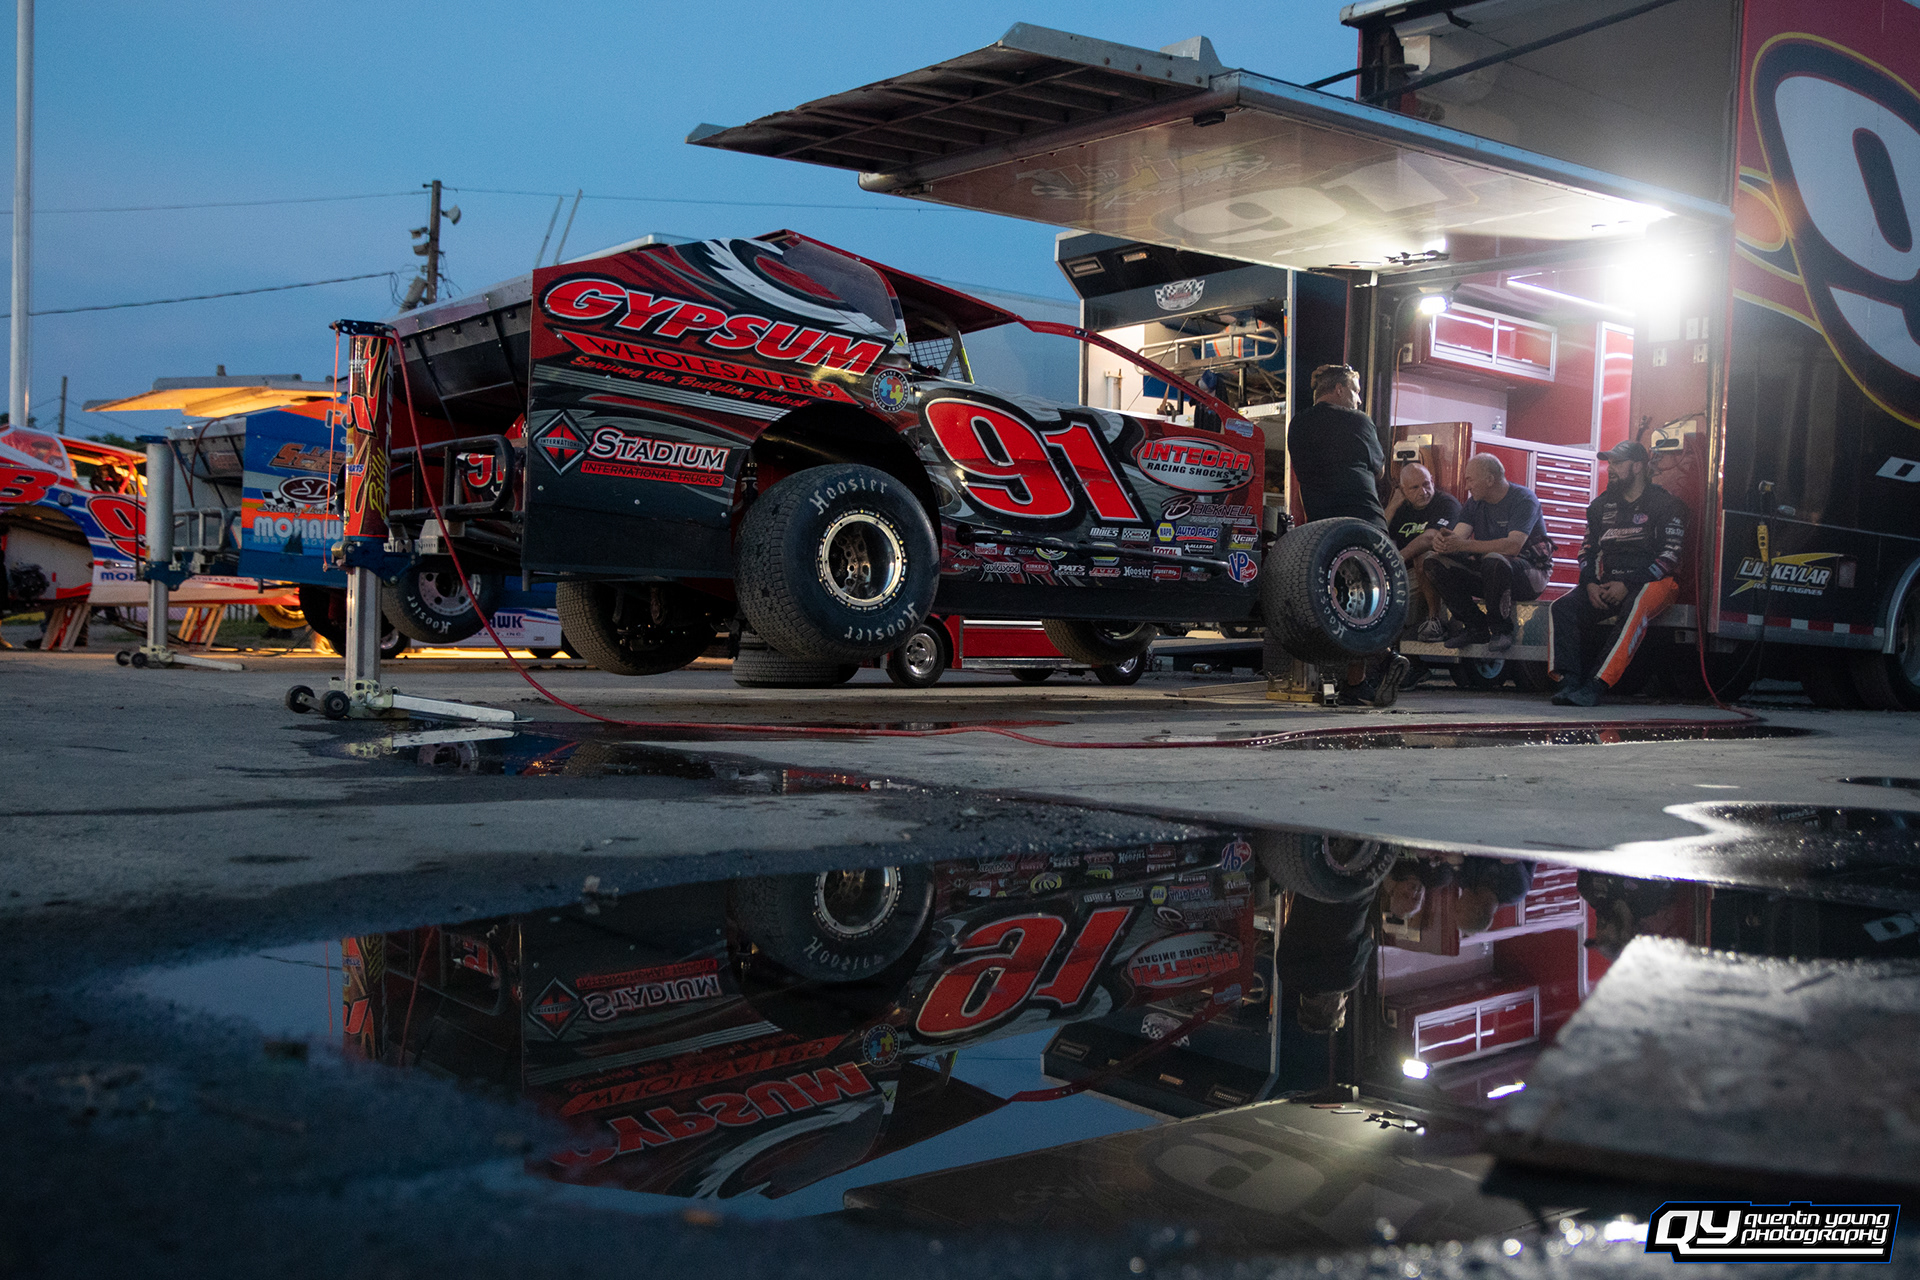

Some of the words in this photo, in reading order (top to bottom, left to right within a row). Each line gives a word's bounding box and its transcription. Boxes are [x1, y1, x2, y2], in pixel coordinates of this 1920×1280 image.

[545, 278, 885, 375] GYPSUM
[585, 338, 836, 398] WHOLESALERS
[645, 370, 677, 384] the
[678, 376, 754, 400] Building
[587, 427, 731, 472] STADIUM
[926, 398, 1142, 522] 91
[1142, 441, 1251, 470] INTEGRA
[584, 463, 669, 482] INTERNATIONAL
[676, 474, 723, 486] TRUCKS
[1147, 462, 1186, 474] RACING
[1189, 467, 1230, 479] SHOCKS
[809, 475, 888, 515] Hoosier
[1192, 503, 1254, 519] BICKNELL
[254, 516, 342, 540] MOHAW
[1159, 527, 1173, 537] NAPA
[1175, 525, 1196, 537] AUTO
[1197, 526, 1219, 538] PARTS
[1123, 565, 1151, 577] Hoosier
[1228, 552, 1249, 580] VP
[1771, 563, 1831, 585] KEVLAR
[1753, 582, 1786, 592] RAING
[1787, 586, 1824, 596] ENGINES
[407, 595, 452, 634] Hoosier
[844, 602, 920, 642] Hoosier
